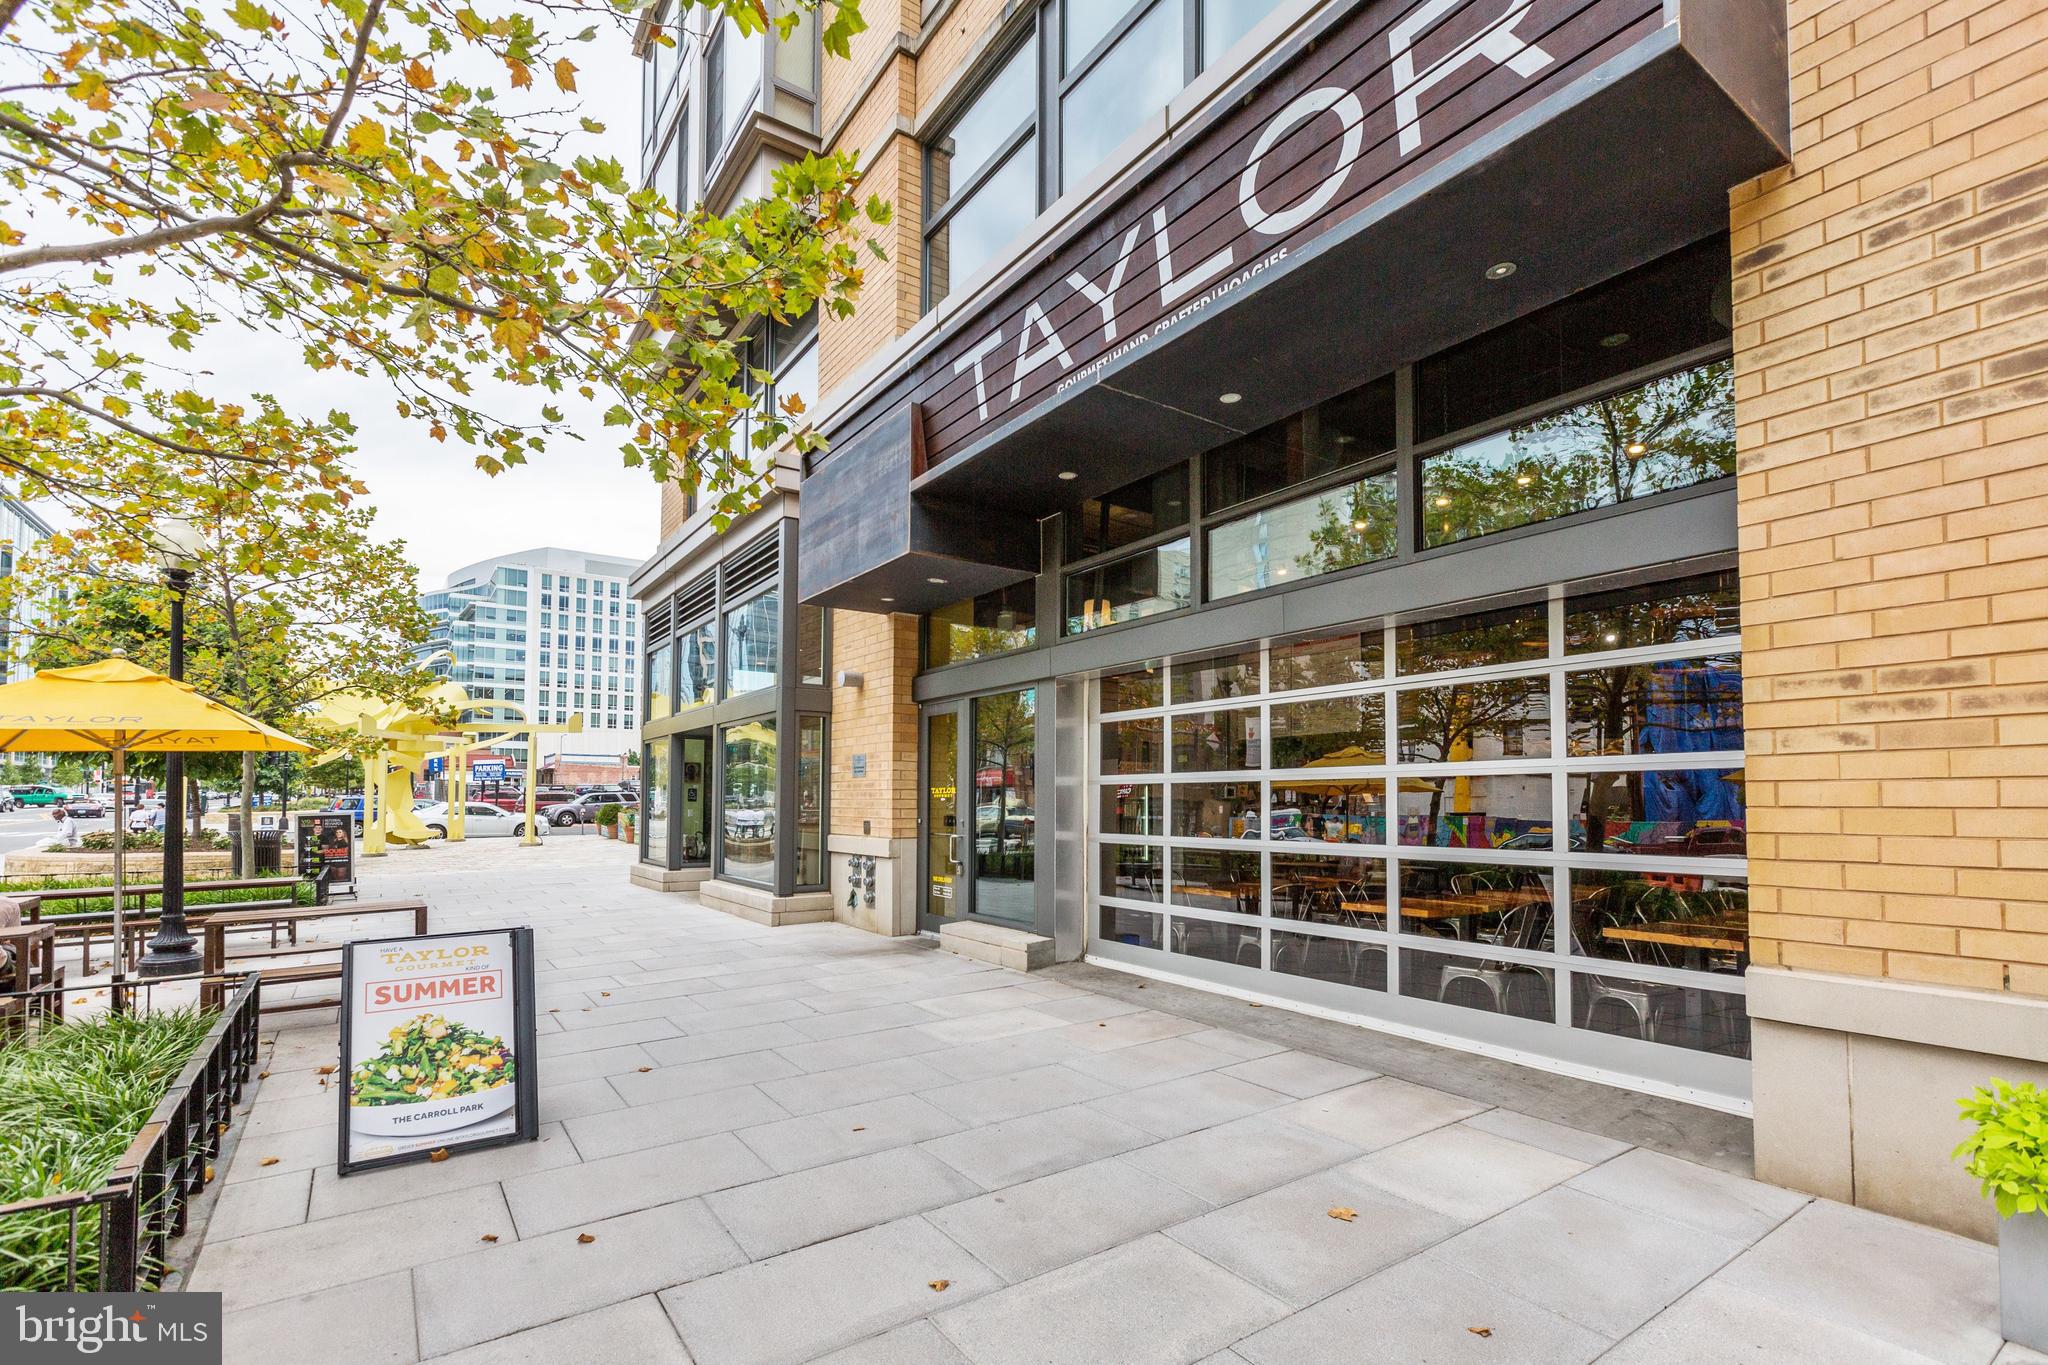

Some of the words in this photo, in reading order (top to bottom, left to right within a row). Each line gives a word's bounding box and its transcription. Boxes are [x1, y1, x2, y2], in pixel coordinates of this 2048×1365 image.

[953, 0, 1556, 422] TAYLOR
[380, 945, 489, 965] TAYLOR
[394, 960, 476, 972] GOURMET
[374, 975, 496, 1005] SUMMER
[392, 1114, 412, 1125] THE
[413, 1108, 459, 1122] CARROLL
[459, 1103, 484, 1114] PARK
